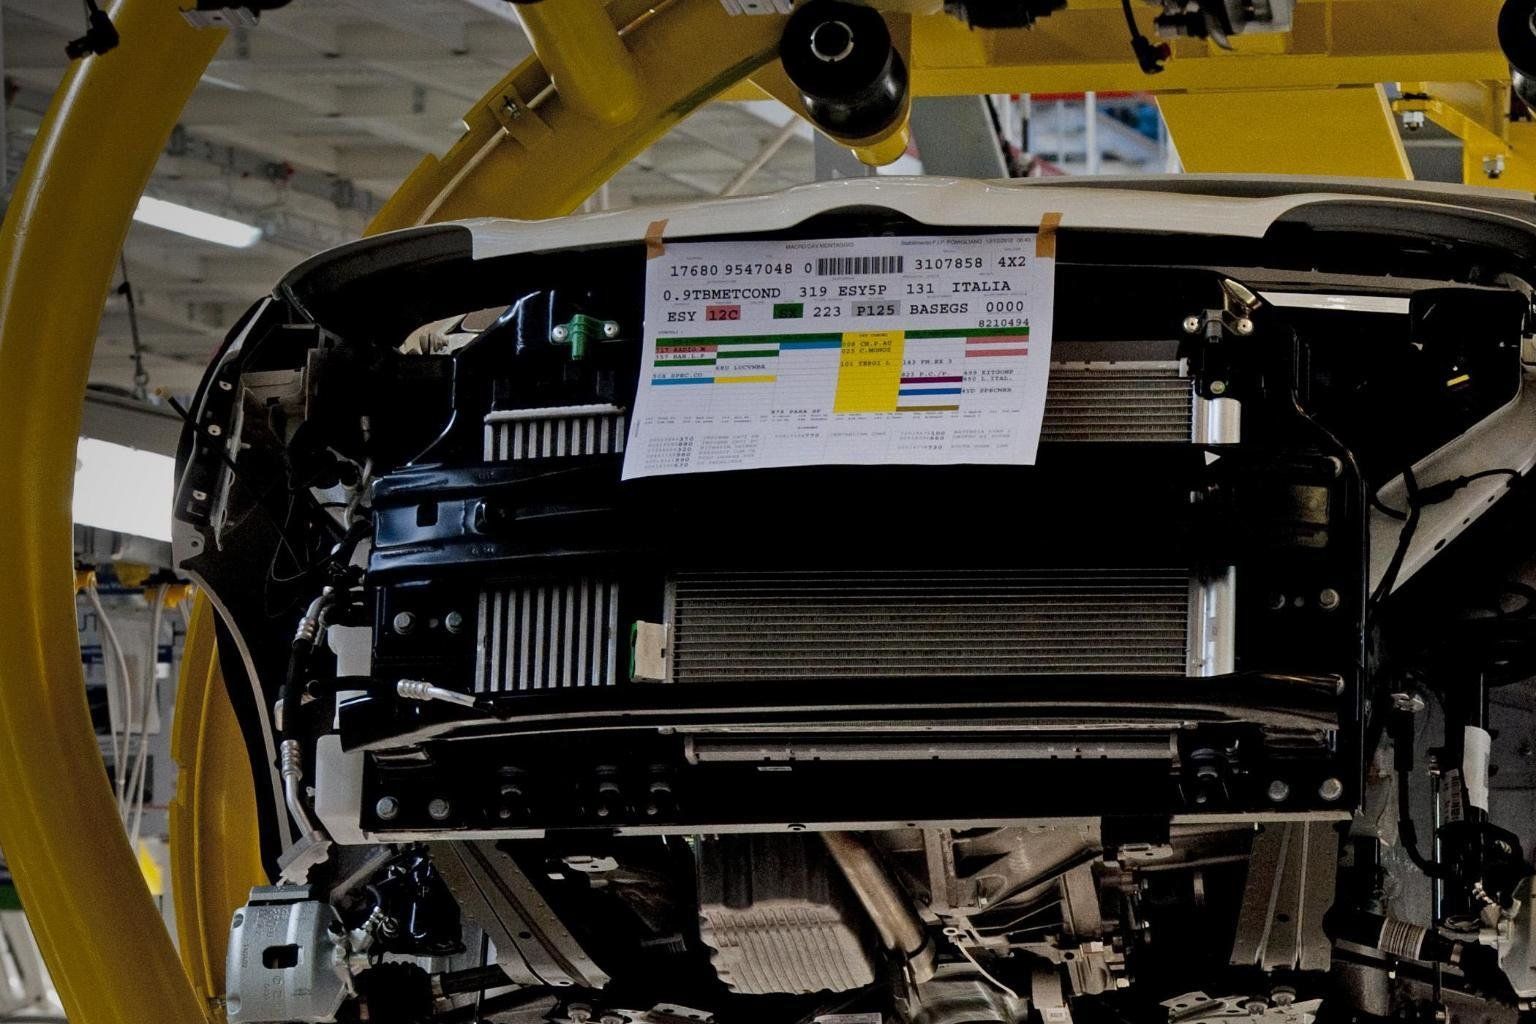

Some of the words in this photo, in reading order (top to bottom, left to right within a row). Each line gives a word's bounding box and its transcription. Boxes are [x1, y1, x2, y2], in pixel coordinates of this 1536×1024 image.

[670, 265, 718, 277] 17680
[725, 263, 793, 275] 9547048
[804, 263, 813, 274] 0
[914, 257, 983, 270] 3107858
[998, 256, 1027, 268] 4X2
[663, 287, 781, 301] 0.9TBMETCOND
[799, 287, 827, 297] 319
[838, 285, 887, 297] ESY5P
[906, 283, 934, 294] 131
[952, 281, 1012, 293] ITALIA
[667, 311, 697, 322] ESY
[709, 309, 739, 320] 12C
[813, 307, 841, 318] 223
[857, 304, 895, 317] P125
[909, 303, 969, 315] BASEGS
[986, 301, 1024, 312] 0000
[978, 318, 1030, 328] 8210494
